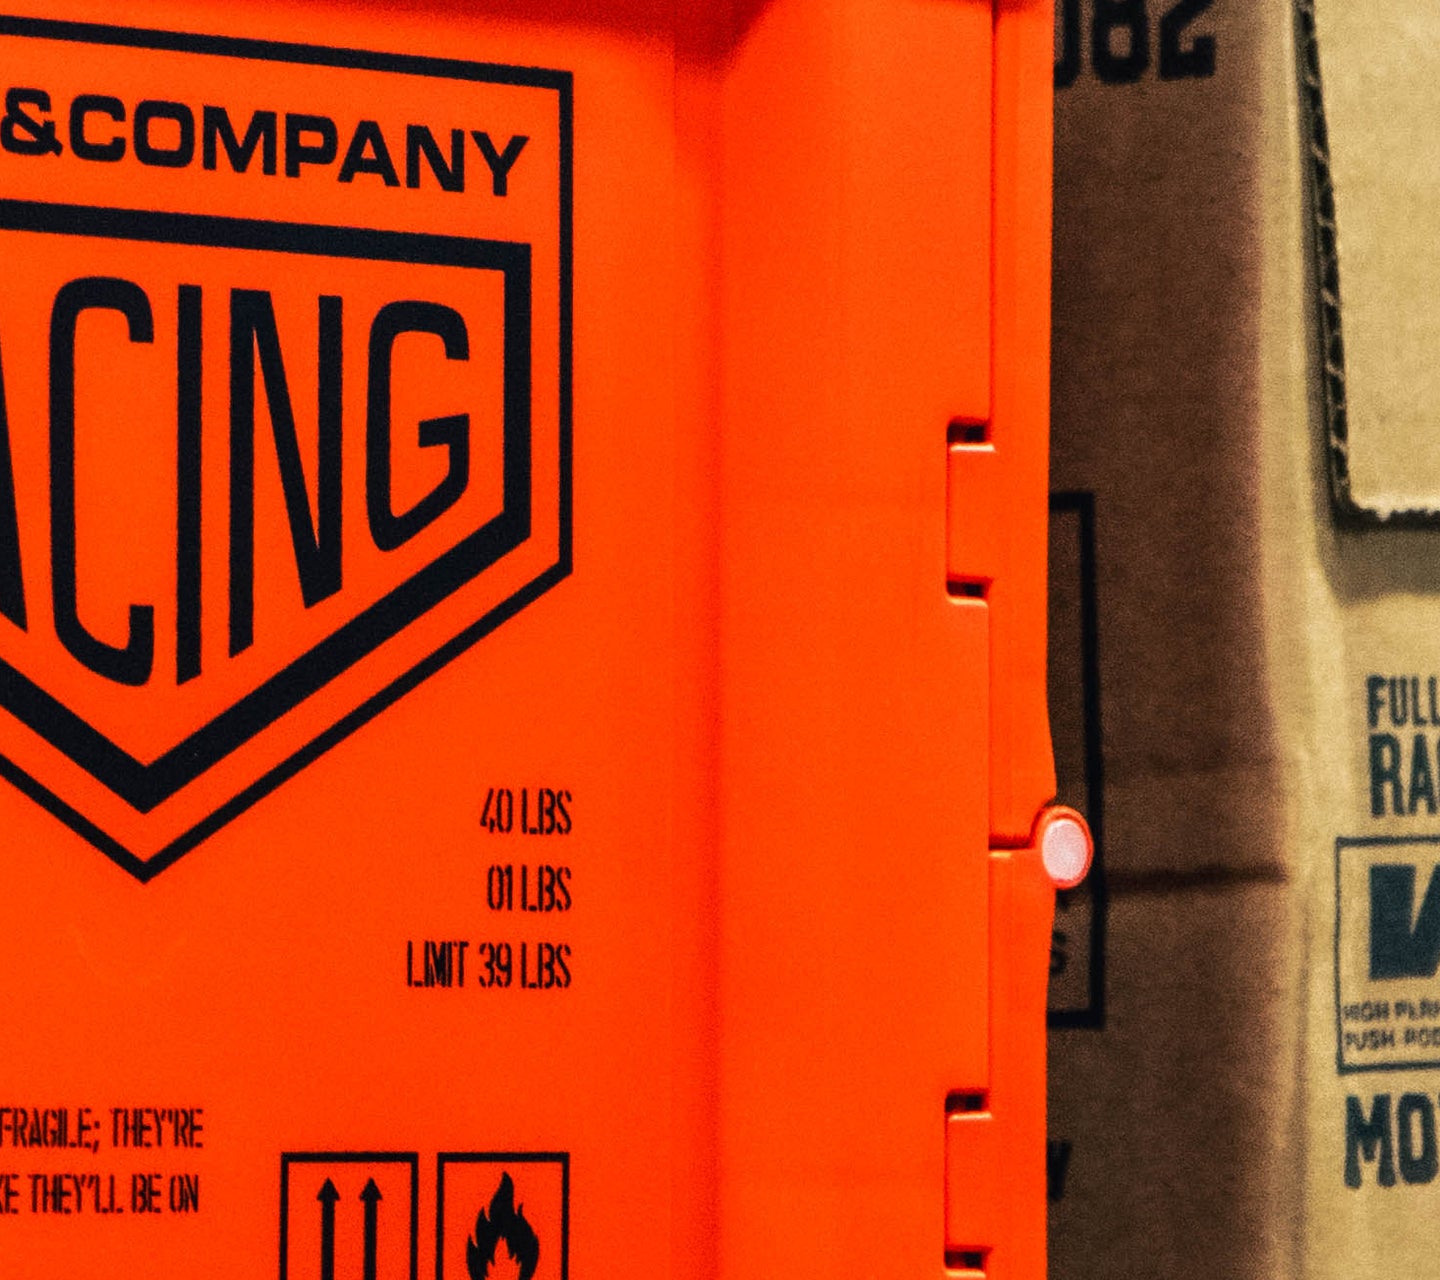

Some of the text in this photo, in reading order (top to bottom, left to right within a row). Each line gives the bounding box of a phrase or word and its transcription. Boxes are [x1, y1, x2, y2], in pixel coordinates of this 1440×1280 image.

[480, 788, 573, 835] 40 LBS
[487, 864, 572, 912] 01 LBS
[407, 940, 572, 989] LIMIT 39 LBS
[109, 1108, 204, 1148] THEY'RE
[28, 1174, 124, 1214] THEY'LL
[131, 1174, 162, 1214] BE
[168, 1174, 199, 1214] ON
